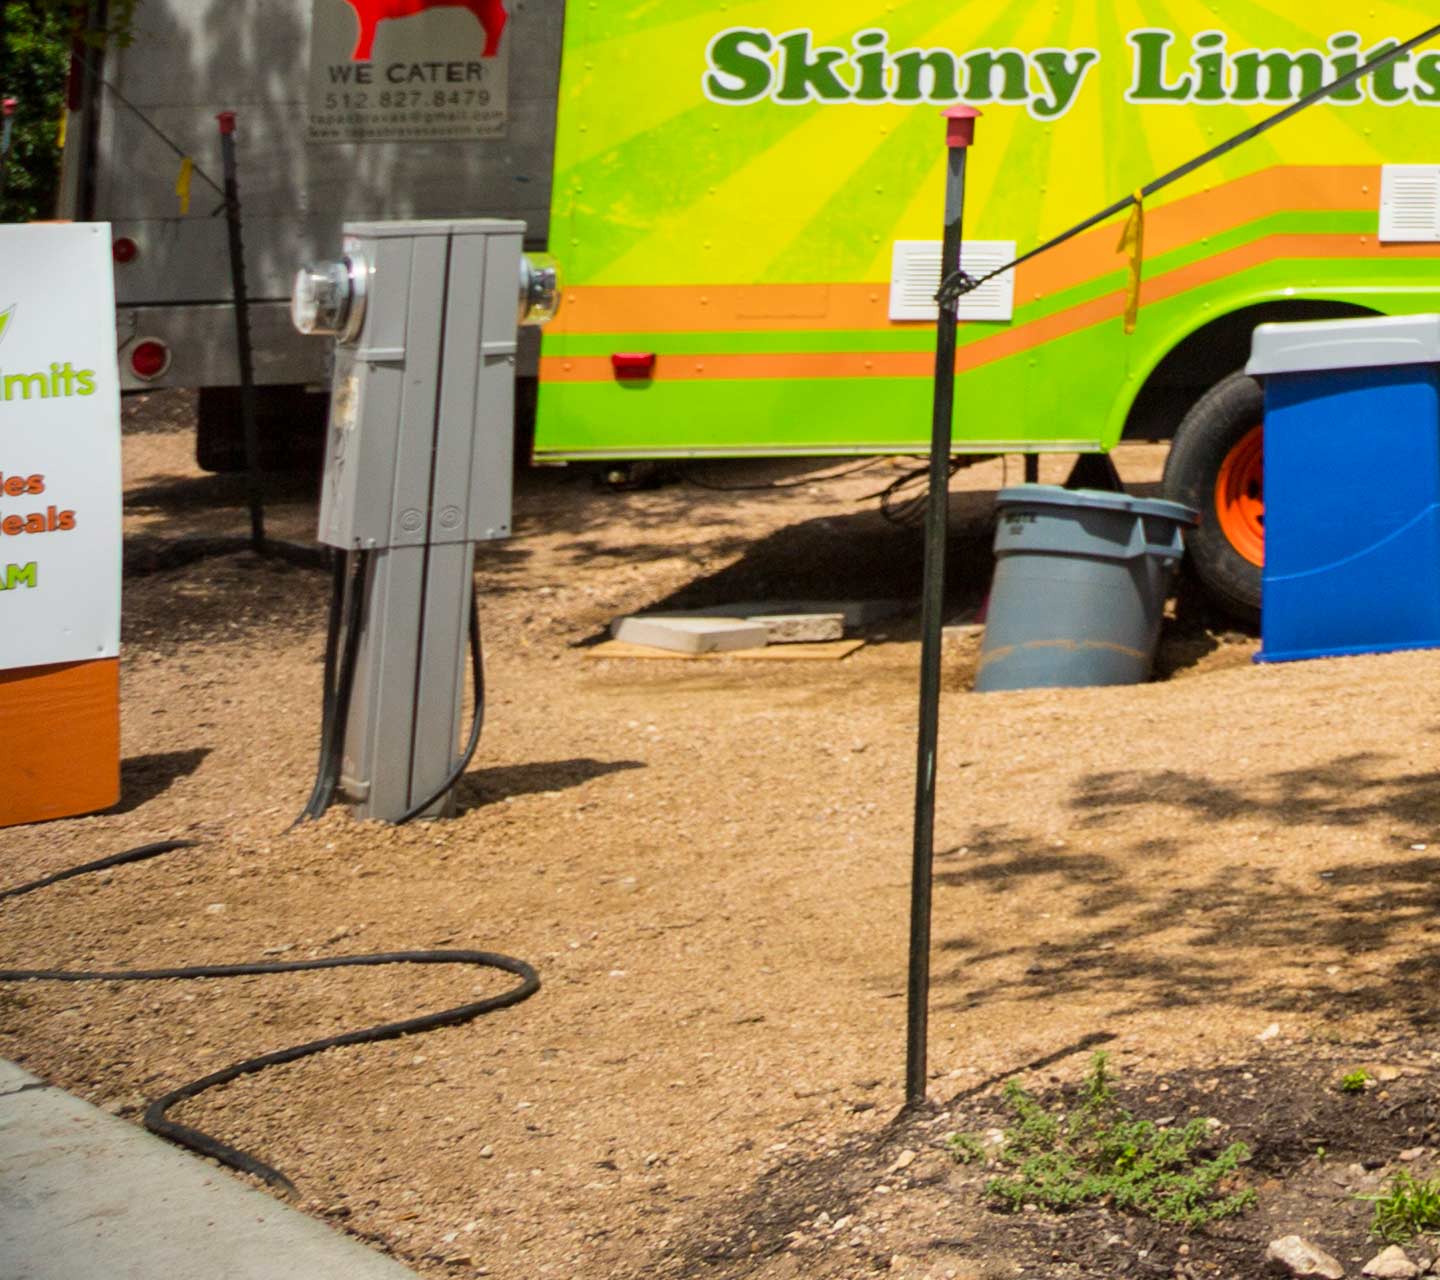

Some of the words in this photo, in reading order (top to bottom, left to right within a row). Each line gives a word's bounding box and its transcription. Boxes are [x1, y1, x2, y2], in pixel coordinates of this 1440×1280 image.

[328, 63, 374, 85] WE
[385, 61, 484, 84] CATER
[703, 27, 1099, 119] Skinny
[325, 89, 491, 110] 512.827.8479
[0, 361, 97, 402] mits
[0, 505, 76, 537] eals
